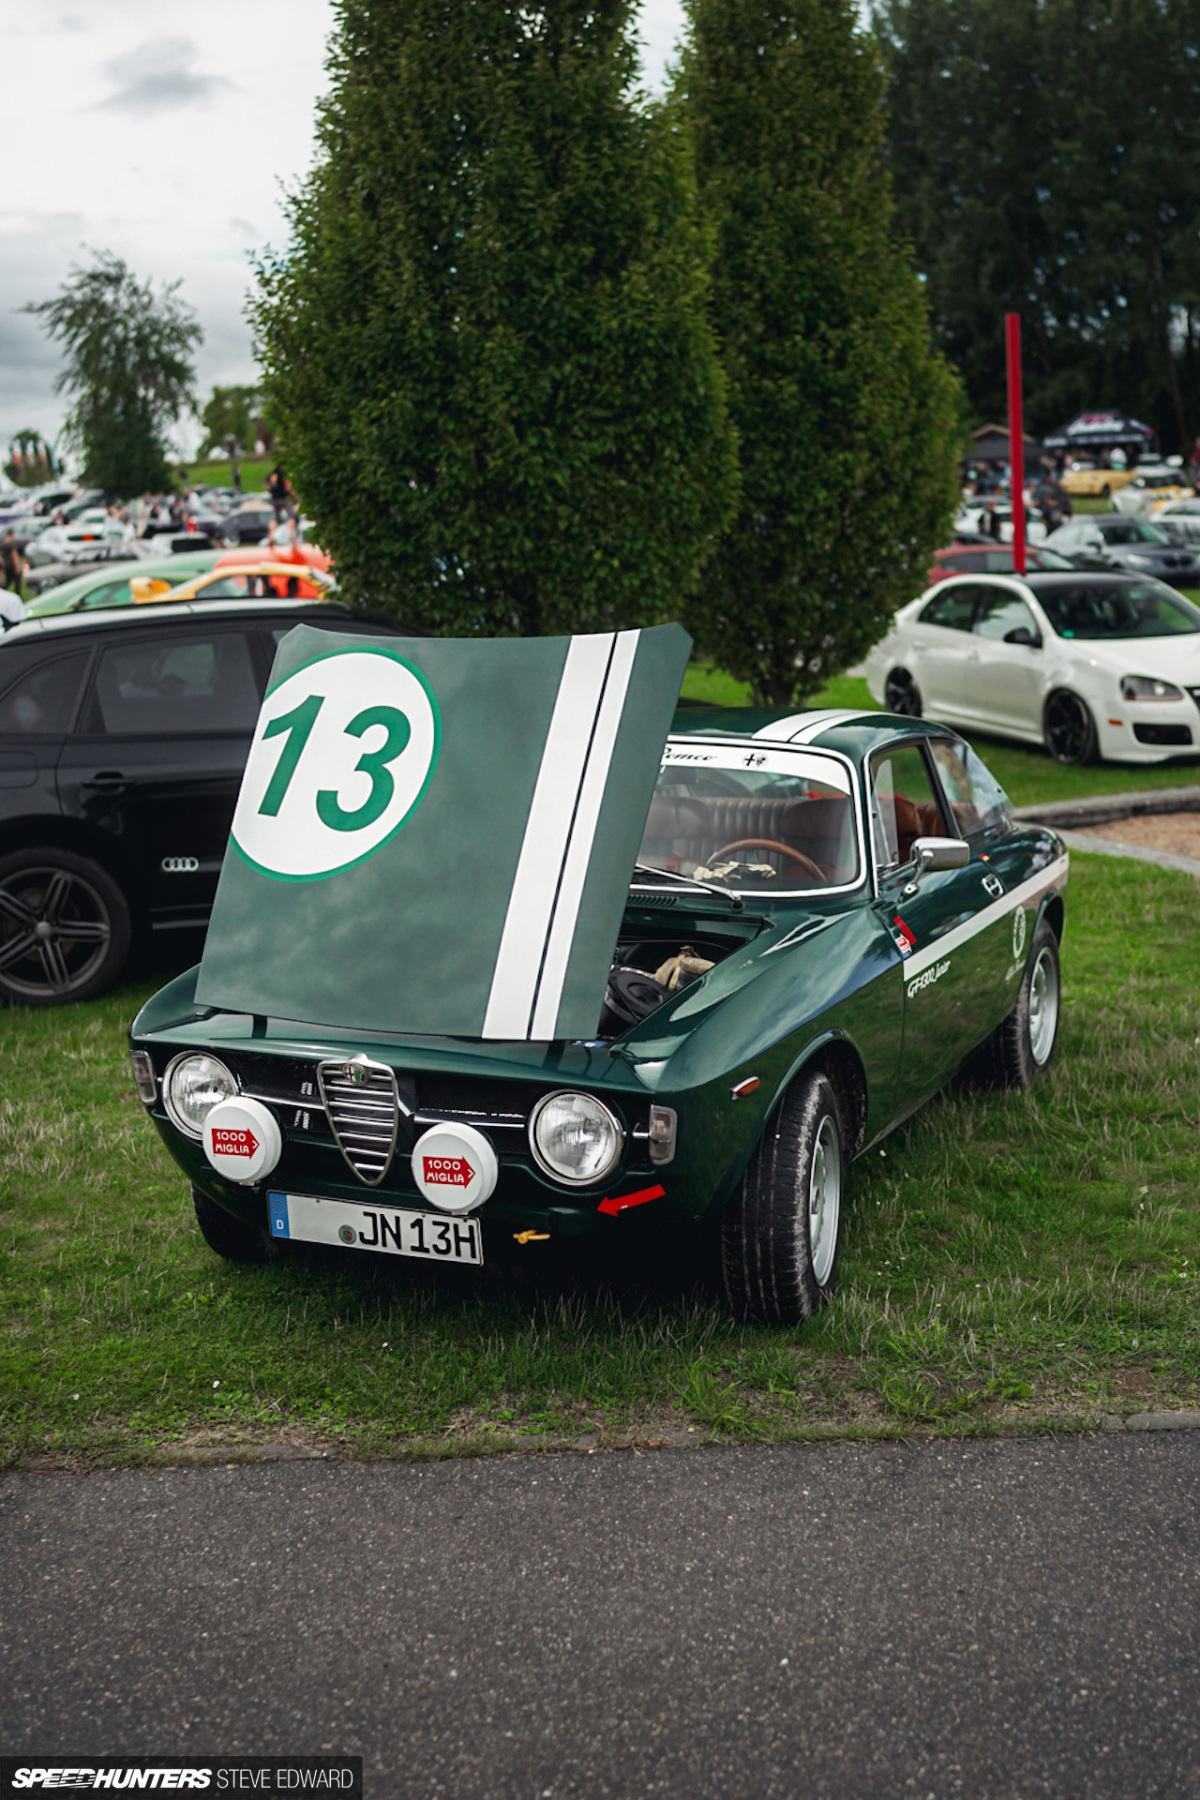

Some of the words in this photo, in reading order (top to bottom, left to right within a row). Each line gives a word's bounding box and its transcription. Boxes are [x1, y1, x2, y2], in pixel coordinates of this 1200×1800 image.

[257, 694, 412, 833] 13
[215, 1131, 247, 1143] 1000
[215, 1143, 250, 1154] MIGLIA
[428, 1159, 461, 1171] 1000
[426, 1171, 464, 1183] MIGLIA
[276, 1219, 285, 1230] D
[358, 1211, 402, 1250] JN
[410, 1218, 477, 1259] 13H
